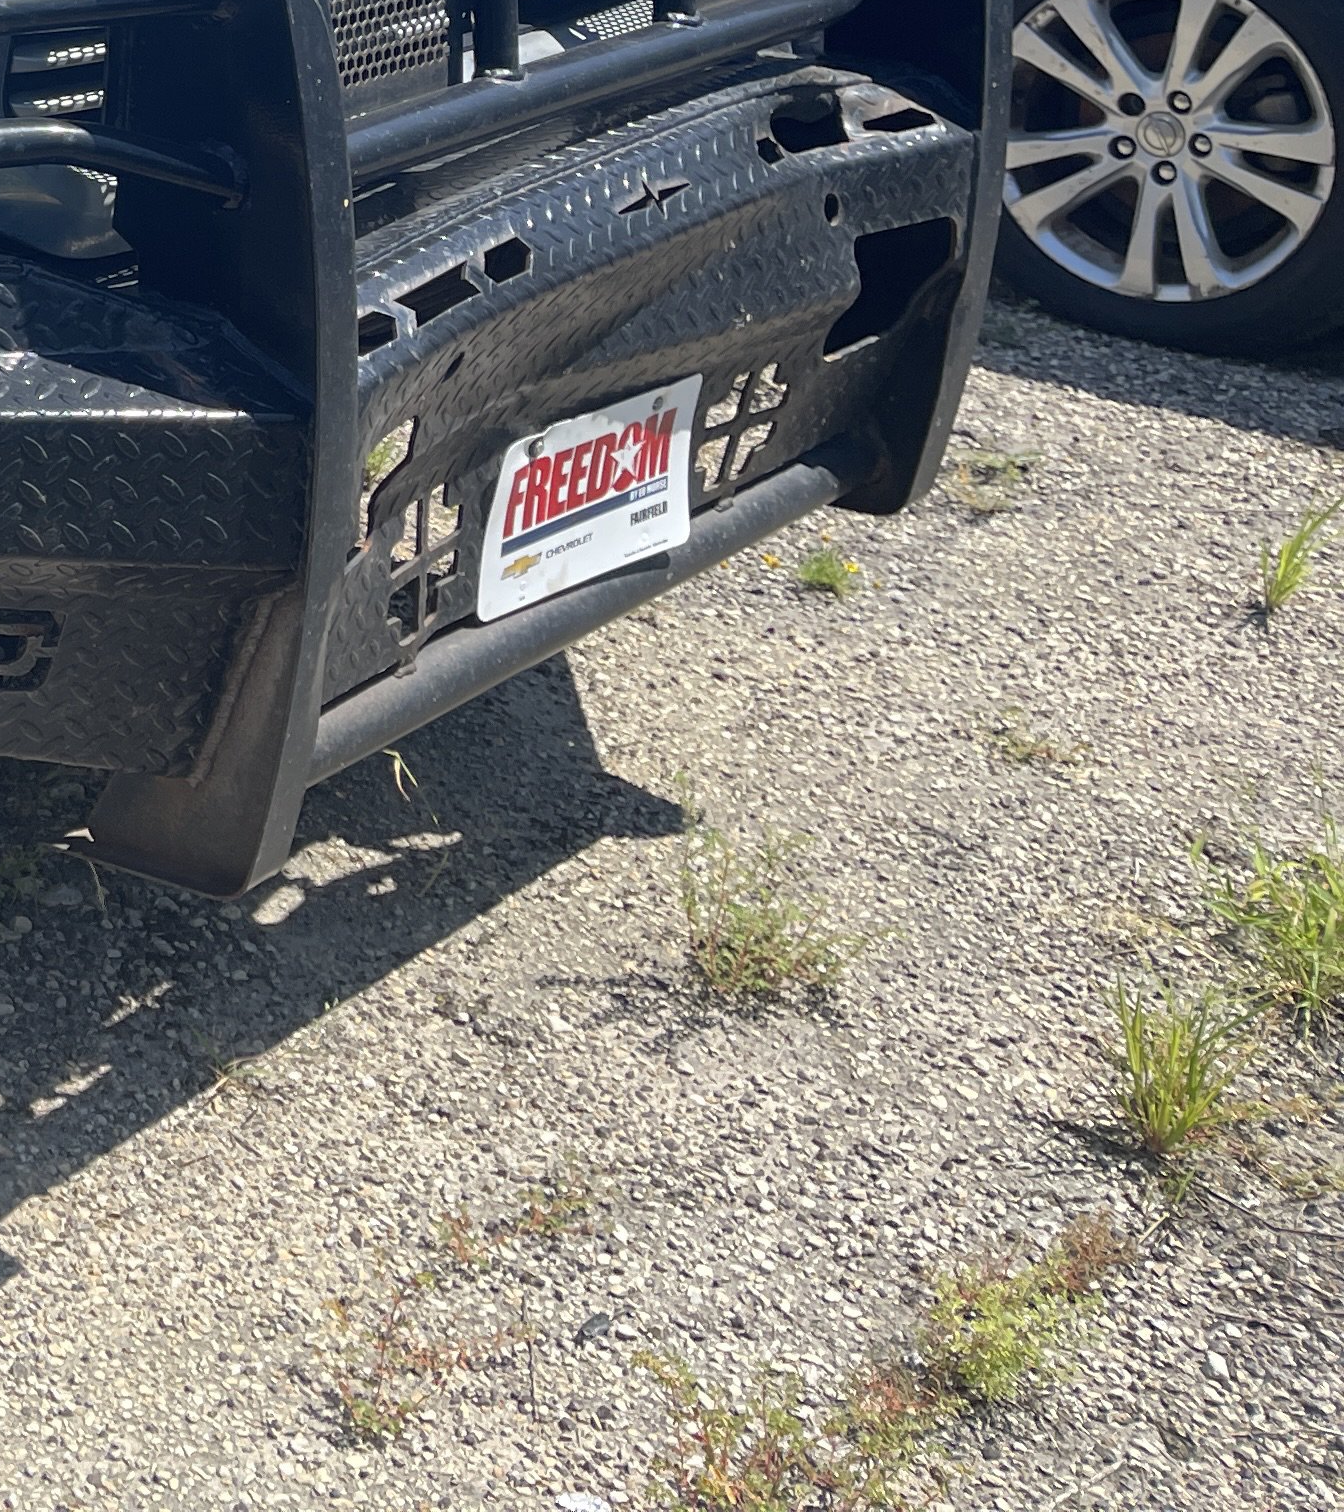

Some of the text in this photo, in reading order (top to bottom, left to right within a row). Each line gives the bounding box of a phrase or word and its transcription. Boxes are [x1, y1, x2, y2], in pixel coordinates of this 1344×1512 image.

[502, 407, 678, 539] FREEDOM
[630, 501, 667, 526] FAIRFIELD
[545, 533, 594, 559] CHEVROLET
